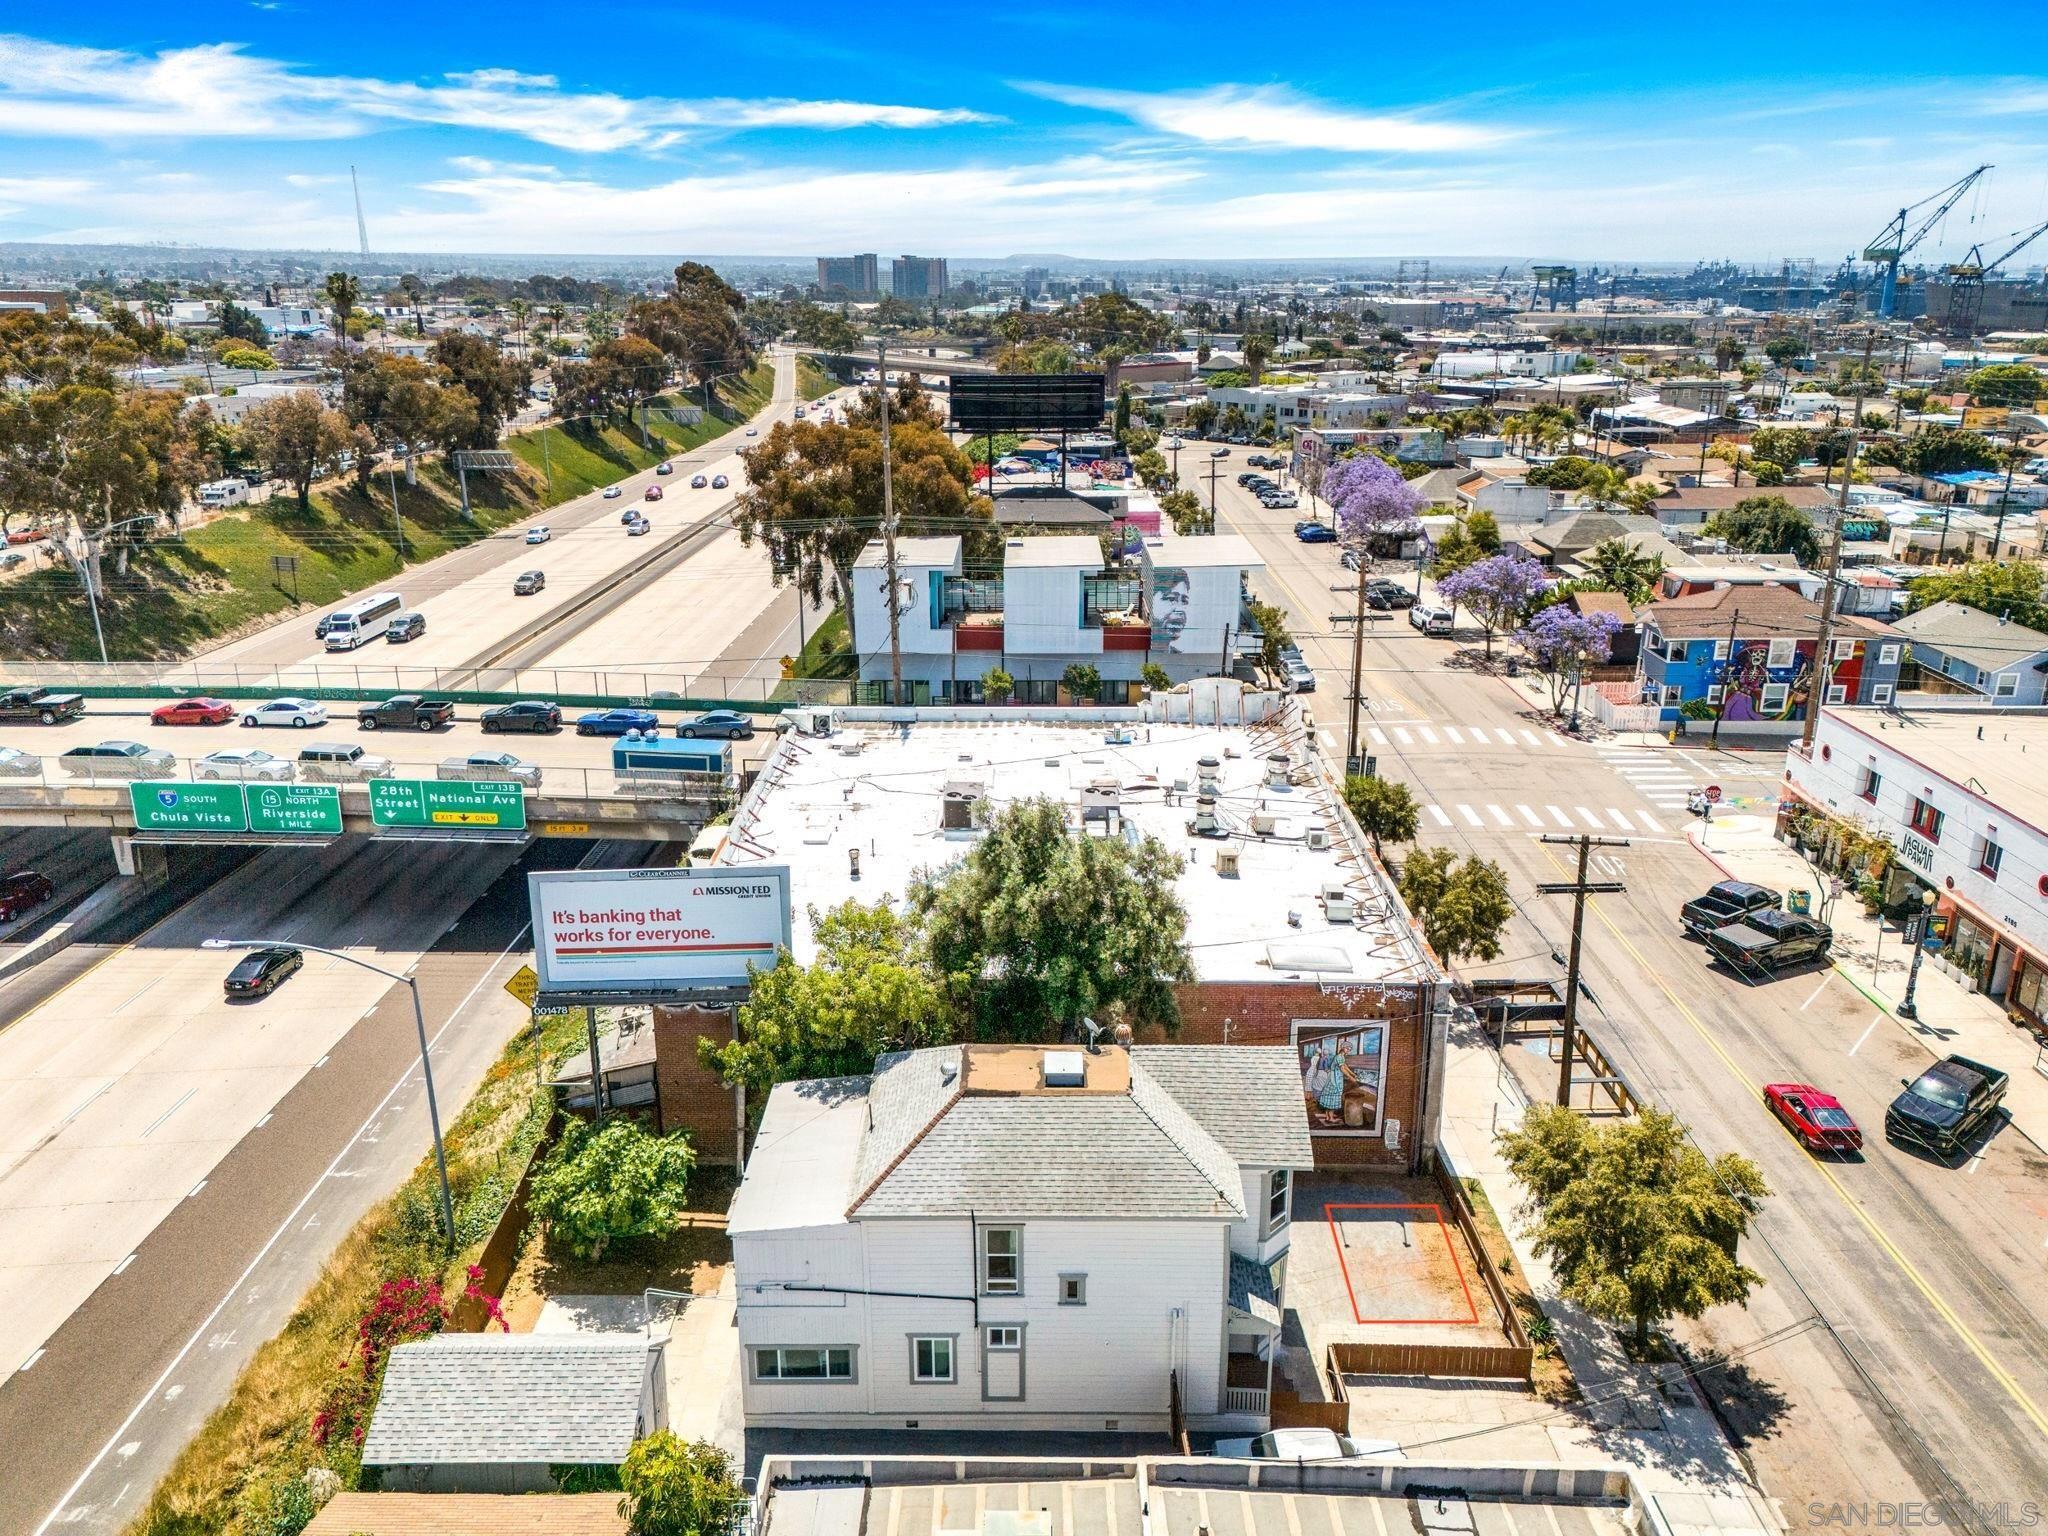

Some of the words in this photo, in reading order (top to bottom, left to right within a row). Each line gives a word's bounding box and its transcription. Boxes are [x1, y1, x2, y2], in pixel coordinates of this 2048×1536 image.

[380, 786, 413, 796] 28th
[498, 784, 516, 792] 13B
[165, 795, 172, 804] 5
[183, 795, 217, 803] SOUTH
[265, 795, 276, 804] 15
[285, 797, 320, 805] NORTH
[375, 798, 419, 808] Street
[429, 793, 486, 804] National
[492, 795, 516, 804] Ave
[150, 812, 189, 822] Chula
[195, 812, 231, 822] Vista
[262, 808, 326, 819] Riverside
[280, 820, 285, 828] 1
[288, 820, 312, 828] MILE
[705, 886, 750, 896] MISSION
[752, 885, 771, 894] FED
[552, 909, 575, 925] It's
[579, 908, 646, 926] banking
[649, 908, 682, 922] that
[554, 928, 605, 943] works
[608, 928, 632, 942] for
[636, 928, 715, 943] everyone.
[1904, 922, 1912, 940] LOGAN
[534, 1007, 568, 1015] 001478
